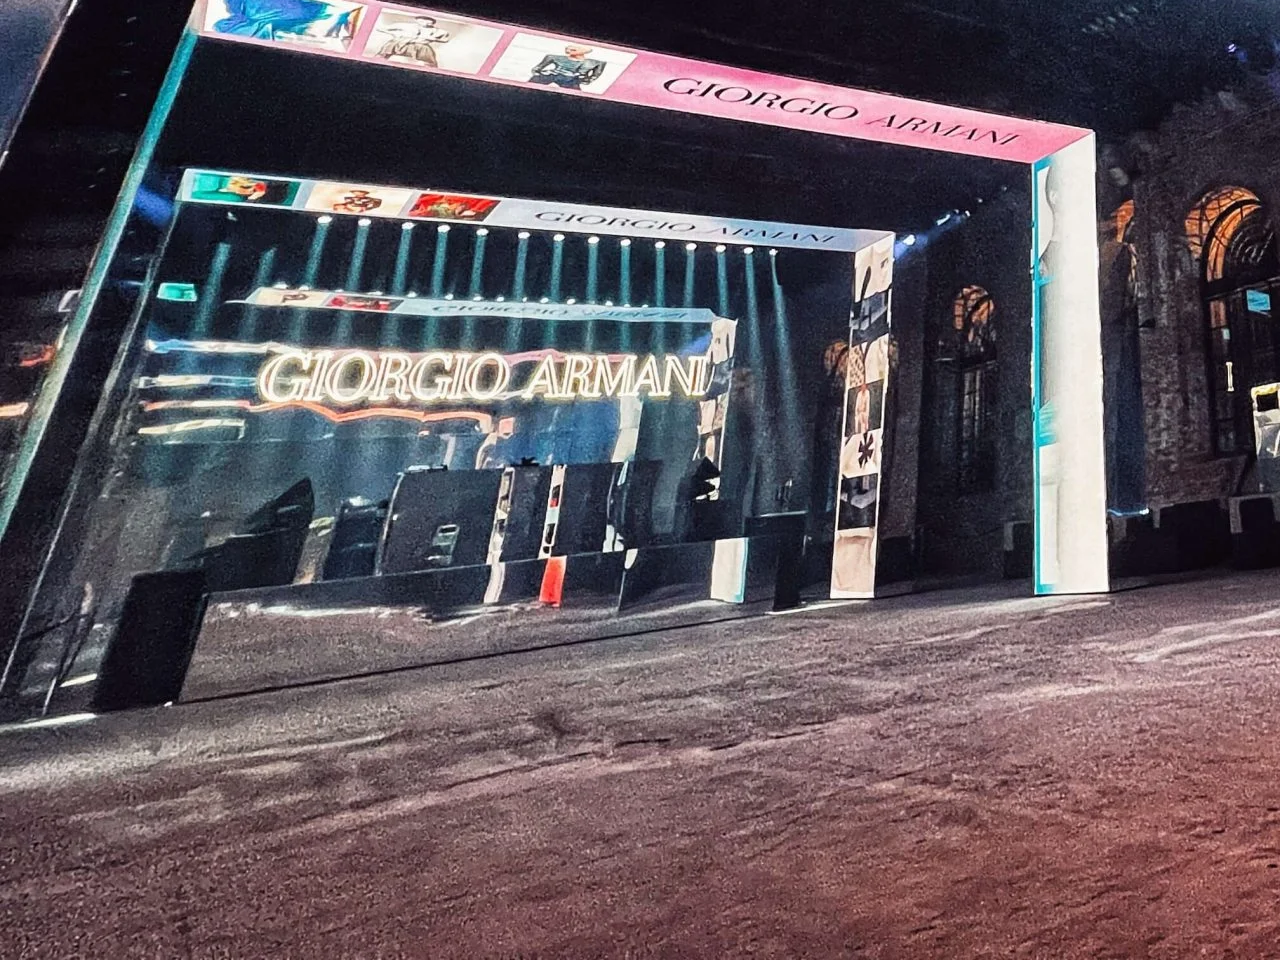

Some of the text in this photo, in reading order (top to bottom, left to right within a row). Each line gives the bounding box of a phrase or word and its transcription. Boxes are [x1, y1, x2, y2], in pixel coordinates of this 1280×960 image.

[662, 77, 1021, 146] GIORGIO ARMANI
[534, 210, 697, 233] GIORGIO
[259, 350, 710, 403] GIORGIO ARMANI
